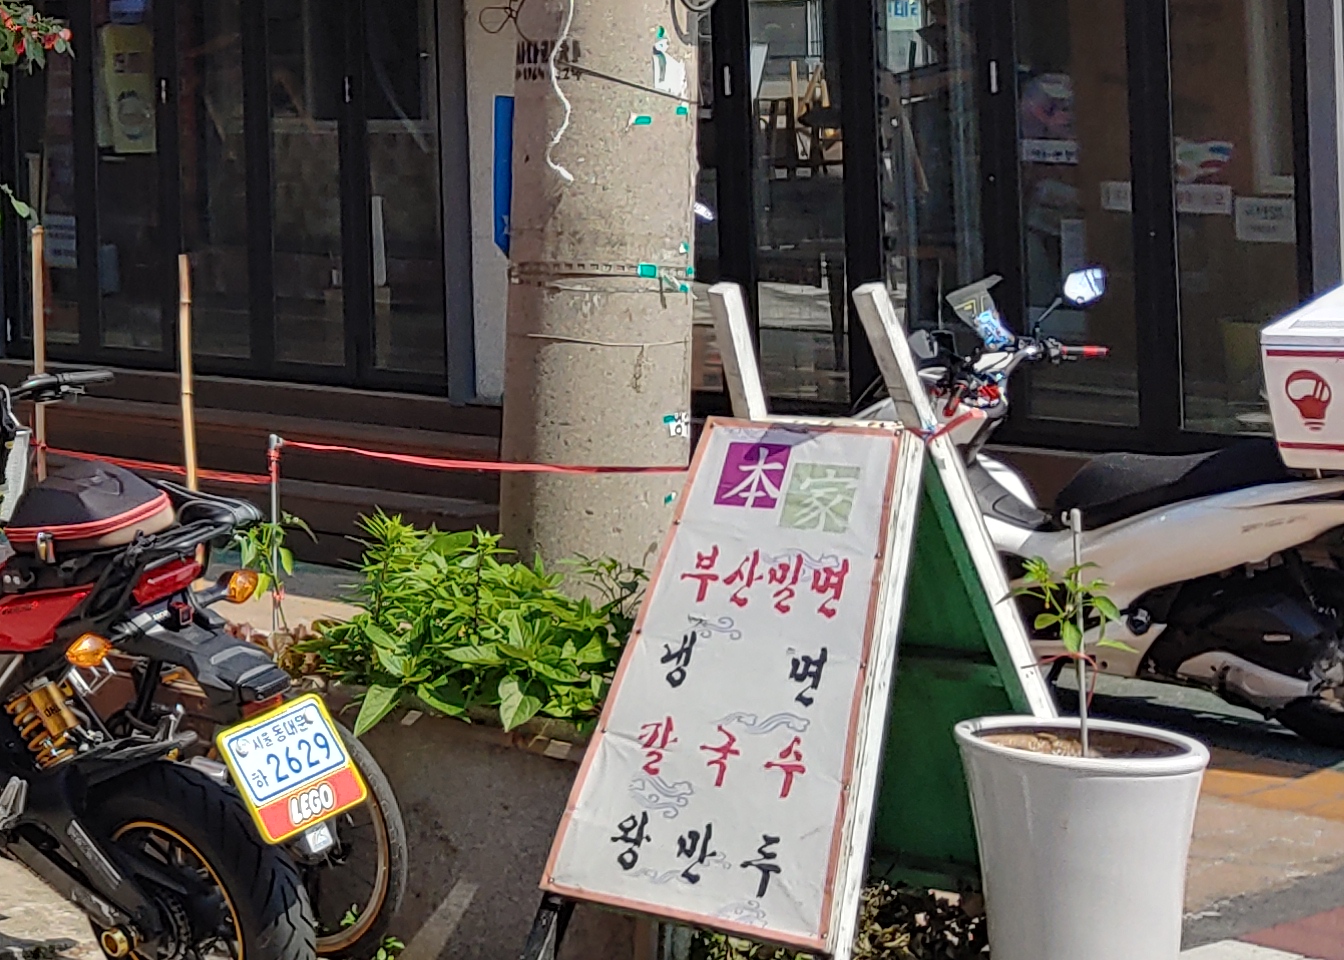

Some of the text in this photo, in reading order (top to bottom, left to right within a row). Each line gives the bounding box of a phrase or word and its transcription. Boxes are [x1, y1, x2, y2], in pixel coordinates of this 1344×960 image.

[680, 544, 850, 620] 부산밀면
[266, 731, 331, 783] 2629
[290, 782, 334, 825] LEGO
